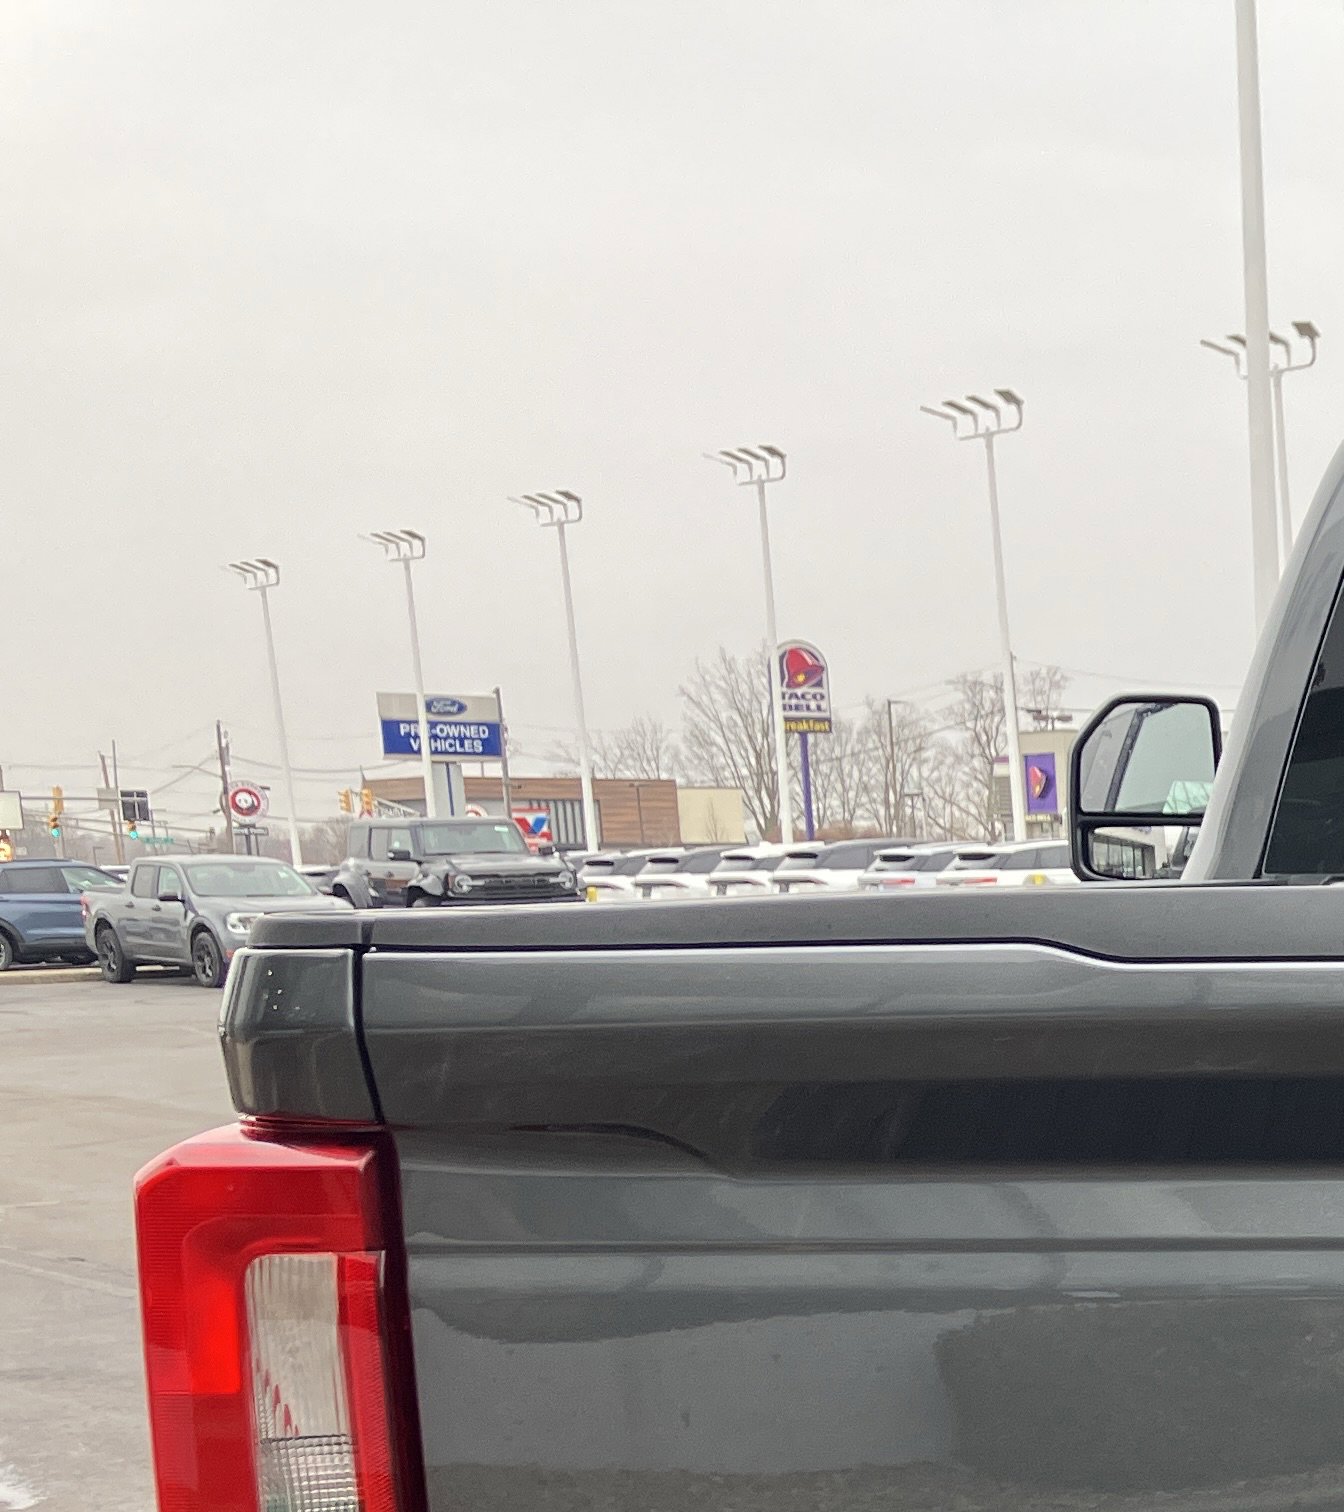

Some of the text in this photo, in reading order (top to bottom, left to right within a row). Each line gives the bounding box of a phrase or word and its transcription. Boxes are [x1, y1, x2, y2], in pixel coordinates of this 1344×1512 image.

[399, 723, 489, 739] PR-OWNED
[784, 720, 829, 733] reakfast
[409, 738, 483, 753] VHICLES
